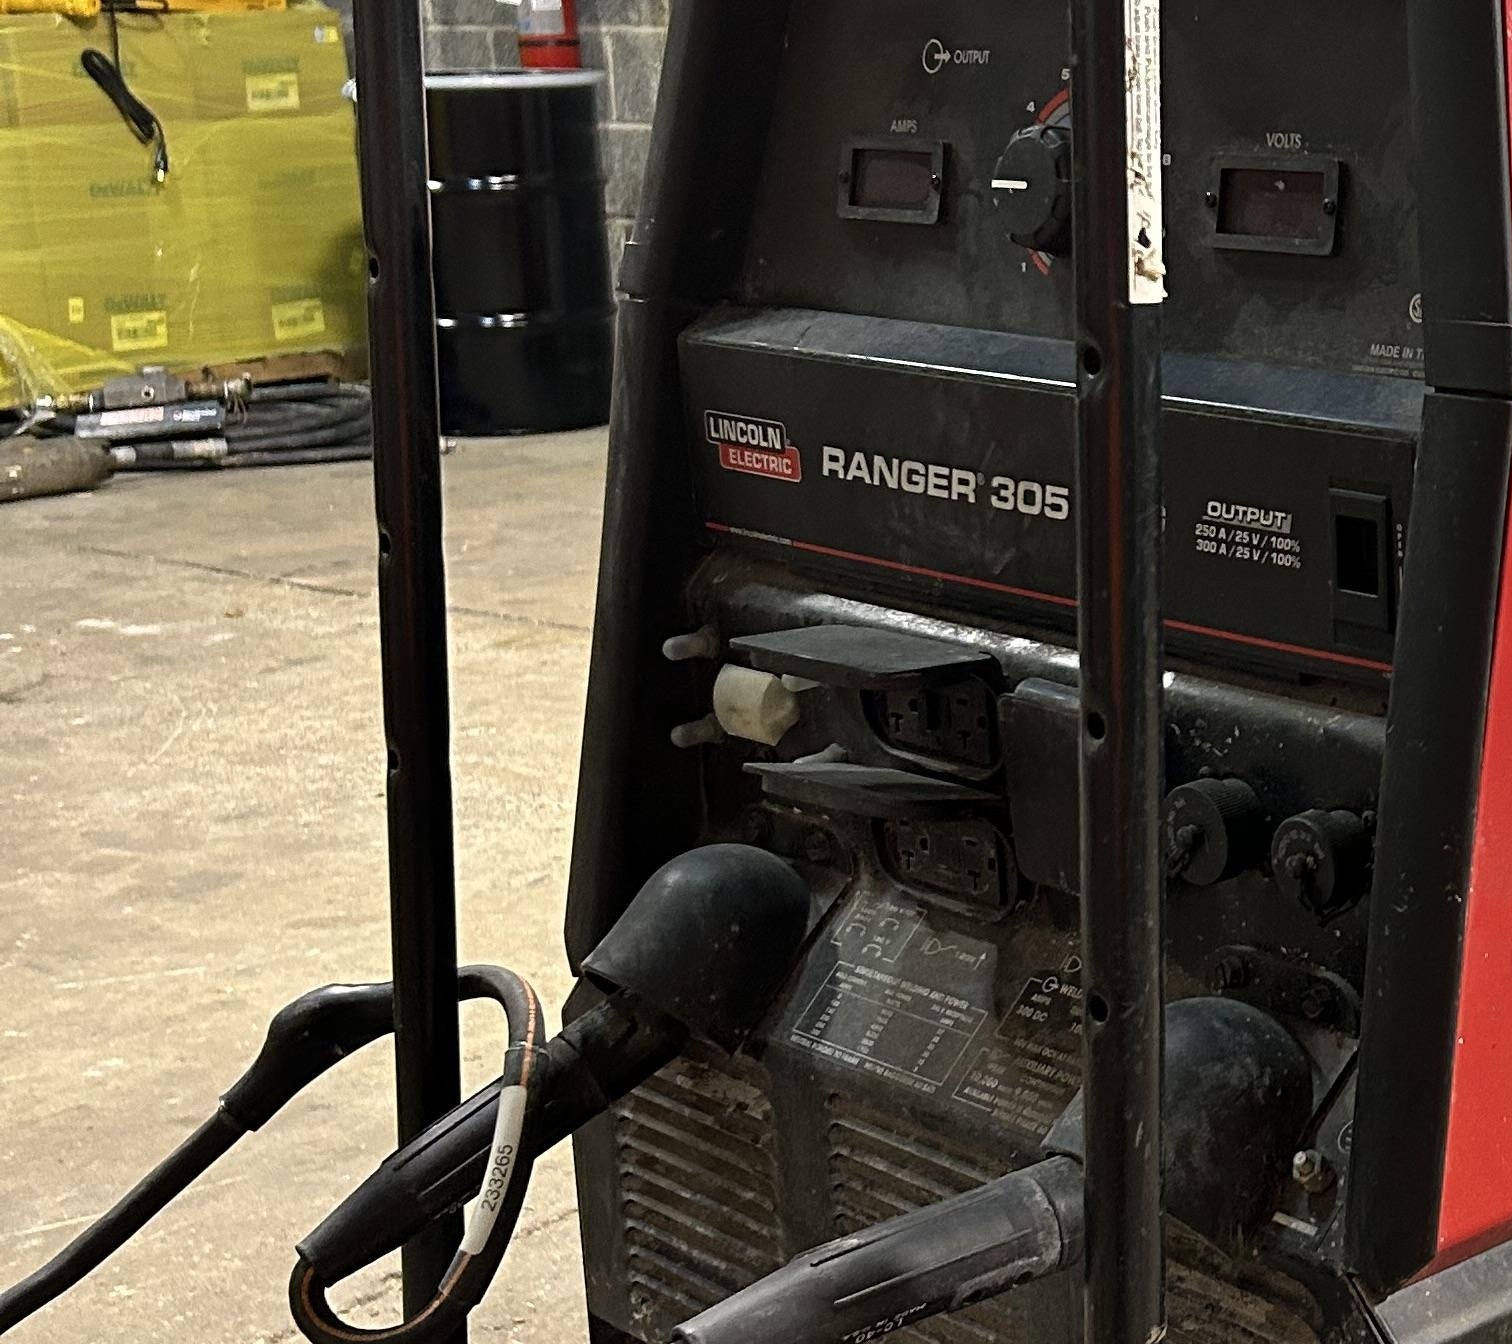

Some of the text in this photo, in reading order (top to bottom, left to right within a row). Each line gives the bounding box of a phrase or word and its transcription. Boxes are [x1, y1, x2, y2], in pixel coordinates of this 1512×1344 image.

[953, 50, 990, 64] OUTPUT
[1061, 68, 1070, 81] 5
[1026, 101, 1035, 113] 4
[890, 119, 918, 134] AMPS
[1266, 133, 1303, 149] VOLTS
[1370, 343, 1400, 358] MADE
[1401, 346, 1414, 359] IN
[709, 417, 782, 449] LINCOLN
[728, 447, 793, 475] ELECTRIC
[990, 476, 1070, 521] 305
[1206, 500, 1288, 529] OUTPUT
[1195, 523, 1216, 538] 250
[1235, 531, 1249, 544] 25
[1270, 536, 1301, 553] 100%
[1196, 538, 1217, 554] 300
[1236, 546, 1251, 560] 25
[1271, 552, 1301, 569] 100%
[481, 1144, 513, 1212] 233265
